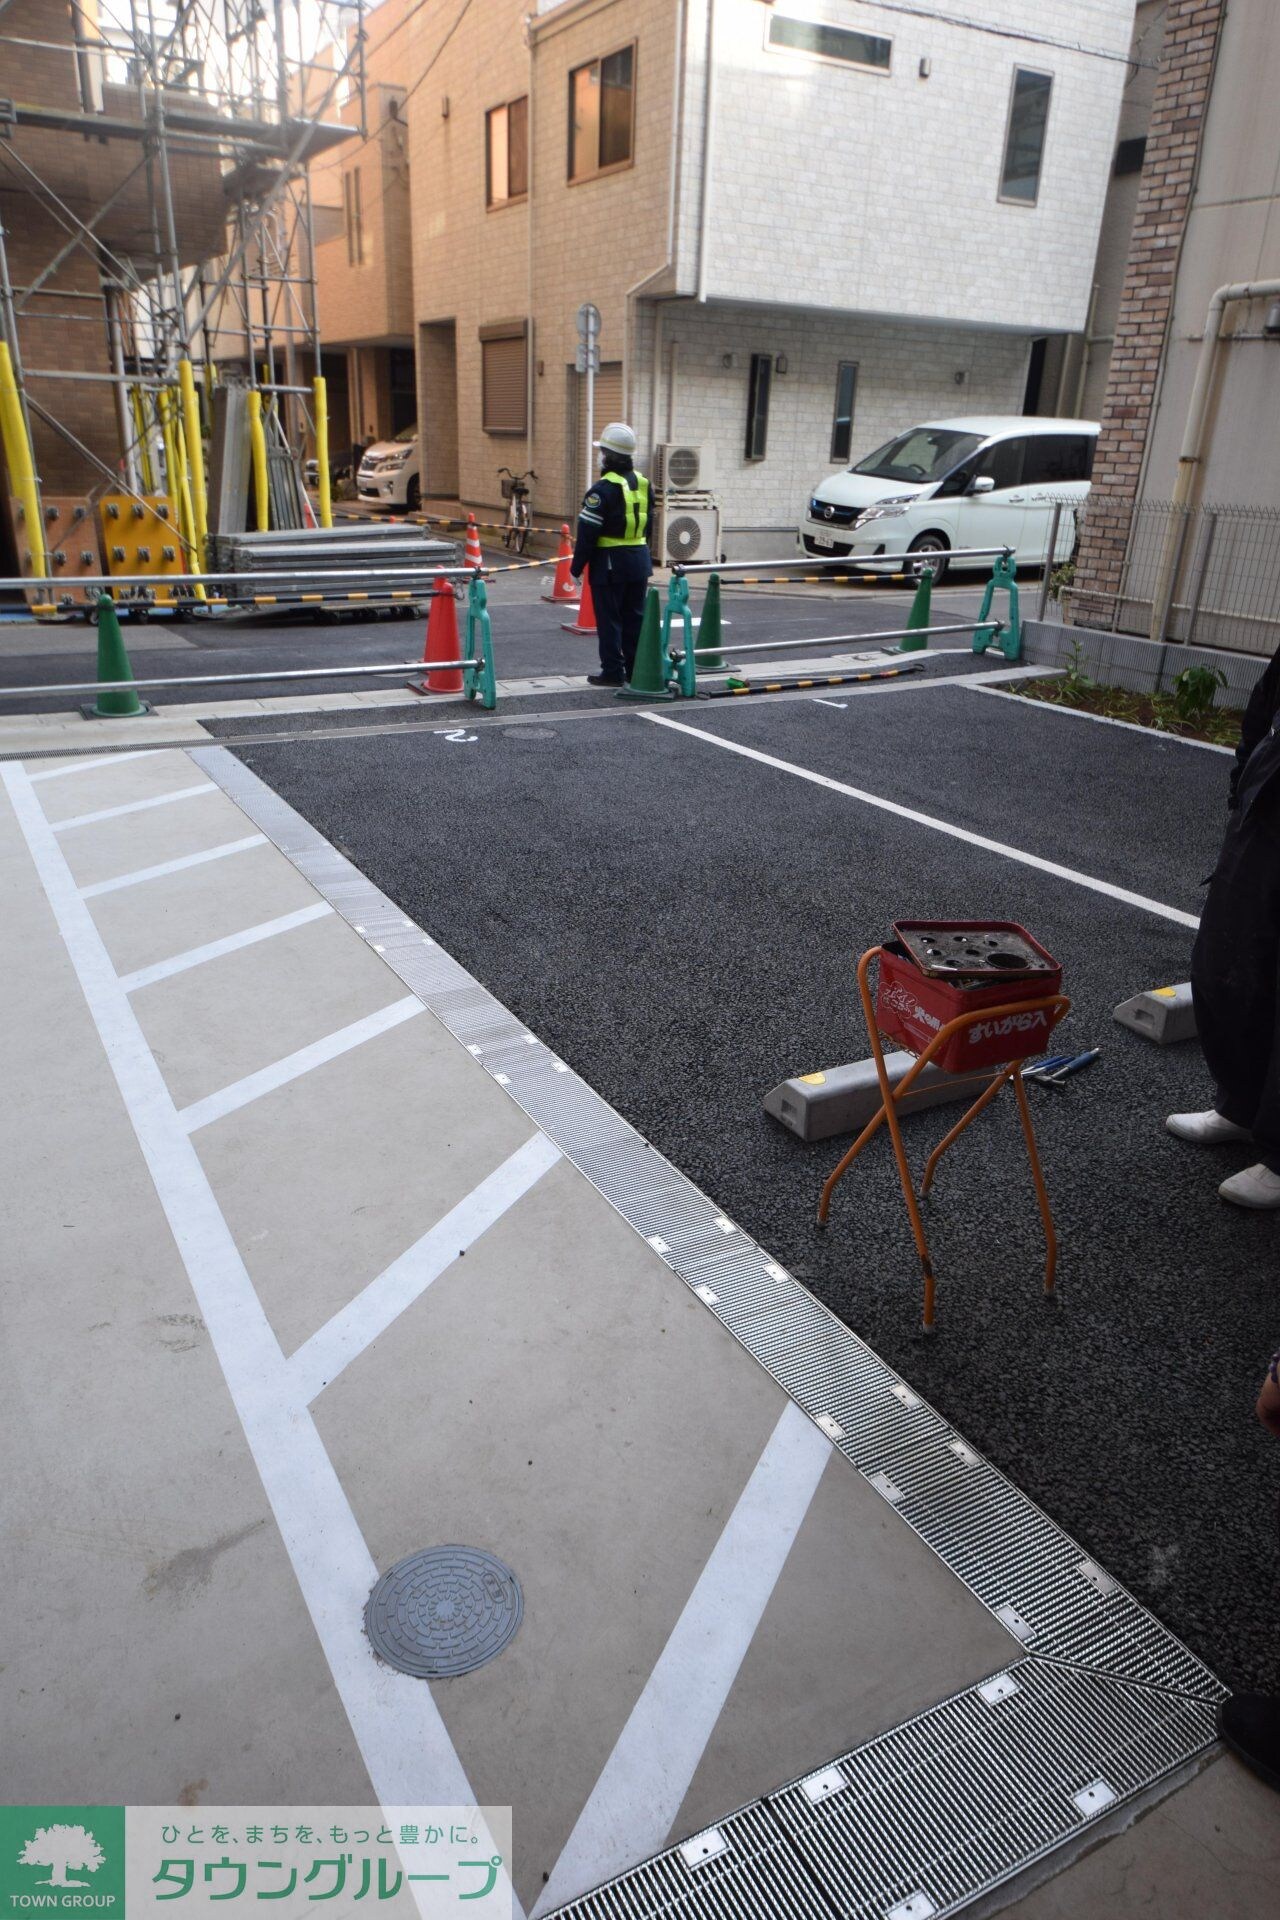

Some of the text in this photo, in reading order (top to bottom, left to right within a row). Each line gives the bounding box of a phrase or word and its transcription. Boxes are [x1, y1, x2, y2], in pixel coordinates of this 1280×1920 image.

[433, 728, 478, 742] 2
[912, 1005, 944, 1032] 火の用
